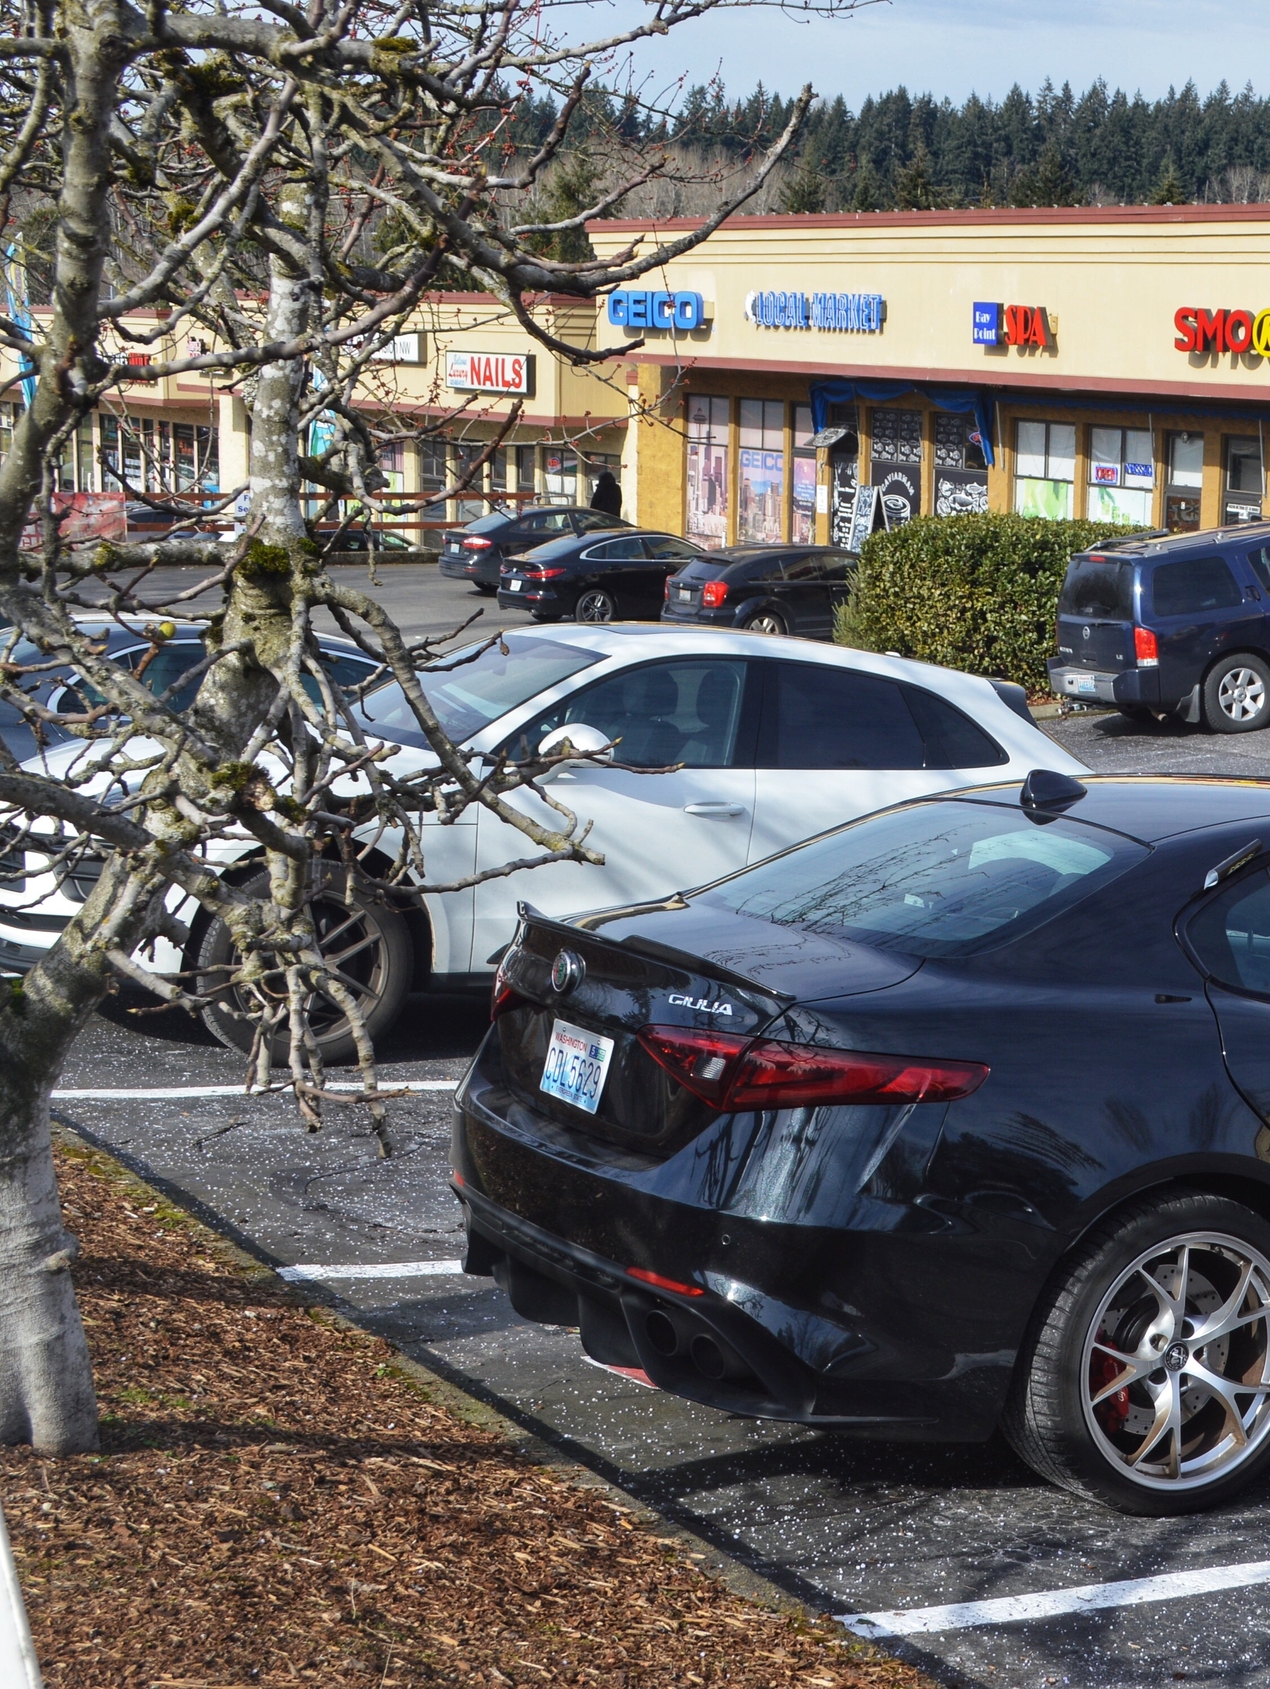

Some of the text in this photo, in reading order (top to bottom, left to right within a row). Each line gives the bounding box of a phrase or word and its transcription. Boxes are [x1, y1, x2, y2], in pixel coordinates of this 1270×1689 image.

[608, 290, 698, 330] GEICO
[755, 291, 882, 330] LOCAL MARKET
[975, 311, 992, 324] Bay
[973, 327, 996, 340] Point
[1004, 304, 1047, 346] SPA
[399, 341, 411, 355] NW
[470, 356, 523, 389] NAILS
[741, 450, 783, 472] GEICO
[668, 993, 733, 1016] GIULIA
[555, 1032, 588, 1053] WASHINGTON
